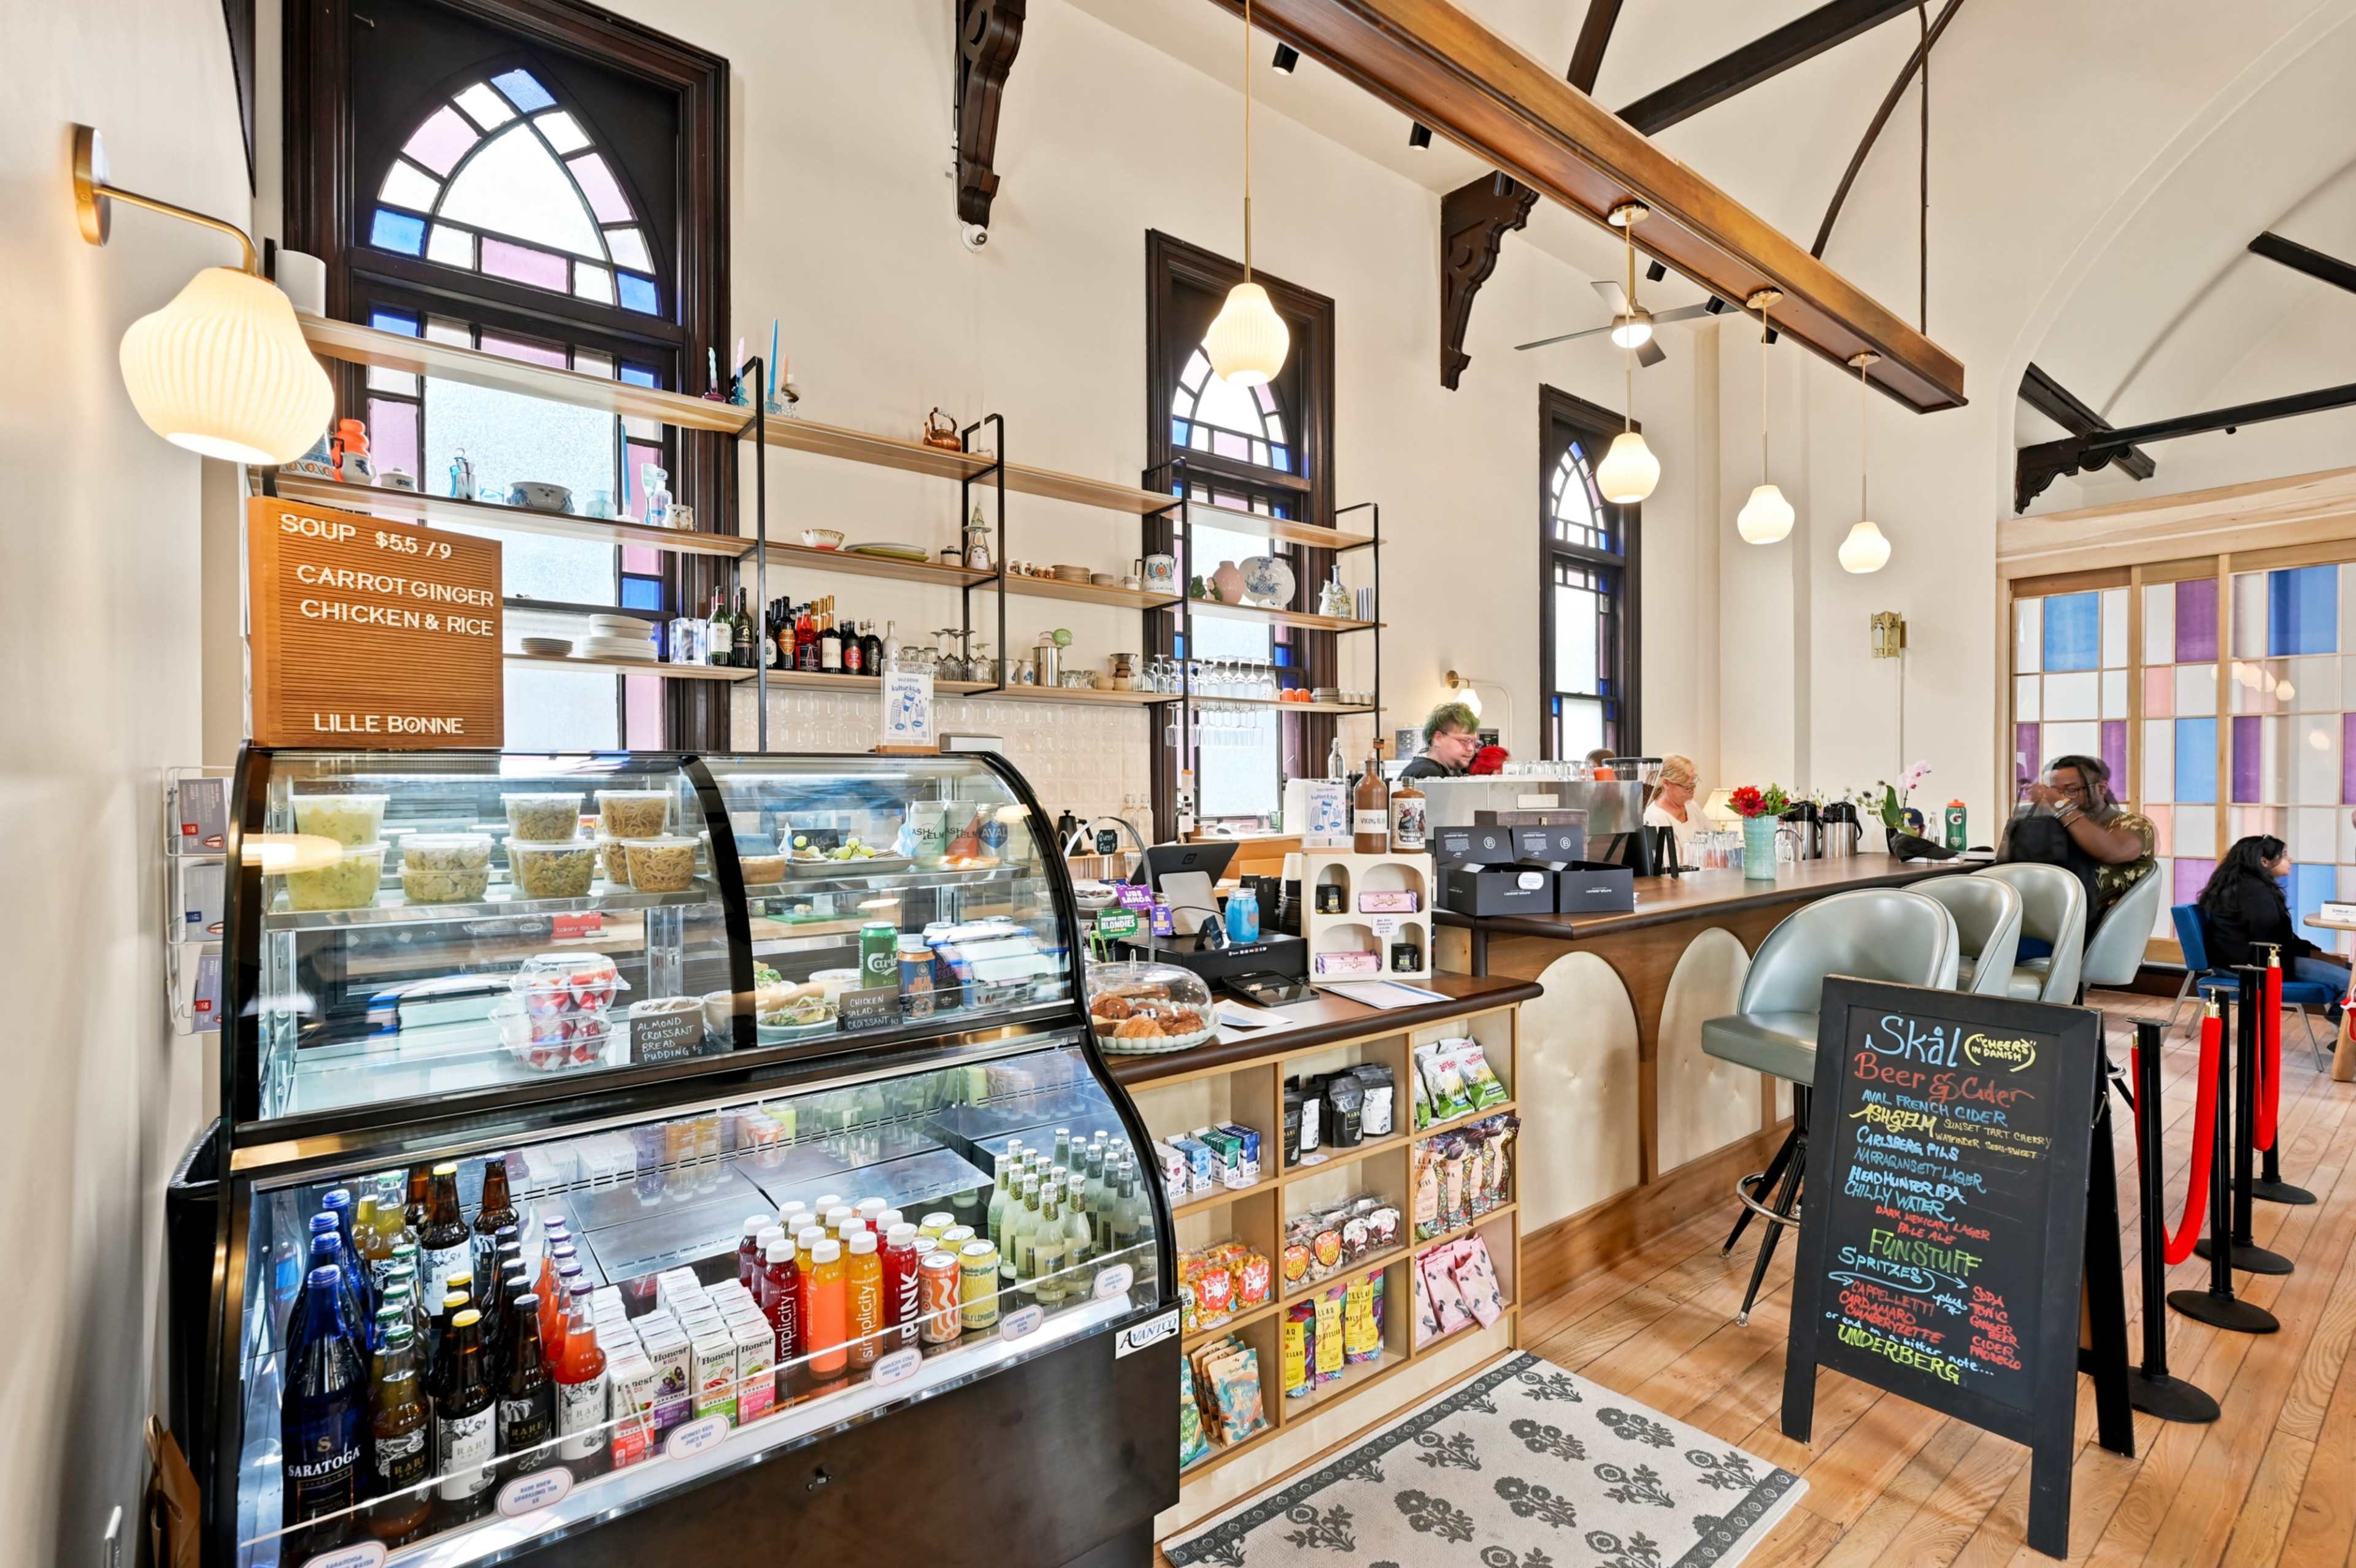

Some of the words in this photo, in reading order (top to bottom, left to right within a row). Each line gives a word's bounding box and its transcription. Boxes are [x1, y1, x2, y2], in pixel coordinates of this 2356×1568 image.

[280, 514, 356, 542] SOUP
[297, 564, 406, 595] CARROT
[410, 580, 494, 607] GINGER
[300, 599, 420, 629] CHICKEN
[425, 613, 440, 631] &
[447, 615, 494, 637] RICE
[314, 712, 380, 733] LILLE
[982, 828, 1007, 838] AVAL
[1101, 918, 1135, 930] BLONDIES
[847, 1007, 873, 1018] SALAD
[850, 994, 884, 1008] CHICKEN
[637, 1017, 682, 1032] ALMOND
[642, 1024, 695, 1041] CROISSANT
[847, 1016, 890, 1031] CROISSANT
[642, 1039, 676, 1053] BREAD
[644, 1047, 689, 1062] PUDDING
[692, 1044, 703, 1055] $8
[1866, 1015, 1961, 1067] Skål
[1971, 1045, 1981, 1055] IN
[1983, 1048, 2022, 1062] DANISH
[1854, 1051, 1927, 1089] Beer
[1961, 1075, 2036, 1108] Cider
[1861, 1089, 1892, 1105] AVAL
[1896, 1094, 1949, 1117] FRENCH
[1955, 1106, 2008, 1128] CIDER
[1857, 1125, 1924, 1156] CARLSBERG
[1927, 1142, 1960, 1162] PILS
[1934, 1132, 1981, 1149] WAYFINDER
[1943, 1118, 1981, 1133] SUNSET
[1983, 1128, 2011, 1140] TART
[2013, 1132, 2052, 1150] CHERRY
[1942, 1166, 1987, 1194] LAGER
[1844, 1180, 1893, 1209] CHILLY
[1895, 1190, 1956, 1223] WATER
[1935, 1183, 1967, 1205] IPA
[1875, 1205, 1901, 1220] DARK
[1904, 1212, 1949, 1232] MEXICAN
[1952, 1223, 1991, 1242] LAGER
[1898, 1221, 1925, 1239] PALE
[1928, 1231, 1958, 1245] ALE
[1838, 1246, 1923, 1284] SPRITZES
[900, 1266, 919, 1339] PINK
[1838, 1289, 1917, 1326] CARDAMARO
[1852, 1280, 1935, 1317] CAPPELLETTI
[1968, 1302, 2008, 1324] TONIC
[776, 1296, 797, 1361] implicity
[1118, 1318, 1177, 1350] AVANTCO
[1842, 1316, 1862, 1329] end
[1888, 1334, 1900, 1343] a
[1903, 1337, 1942, 1356] bitter
[653, 1347, 689, 1364] Honest
[701, 1349, 736, 1366] Honest
[741, 1338, 774, 1353] Honest
[1838, 1323, 1960, 1386] UNDERBERG
[1972, 1335, 2015, 1362] CIDER
[511, 1420, 545, 1437] RARE
[317, 1436, 333, 1453] S
[288, 1445, 361, 1477] SARATOGA
